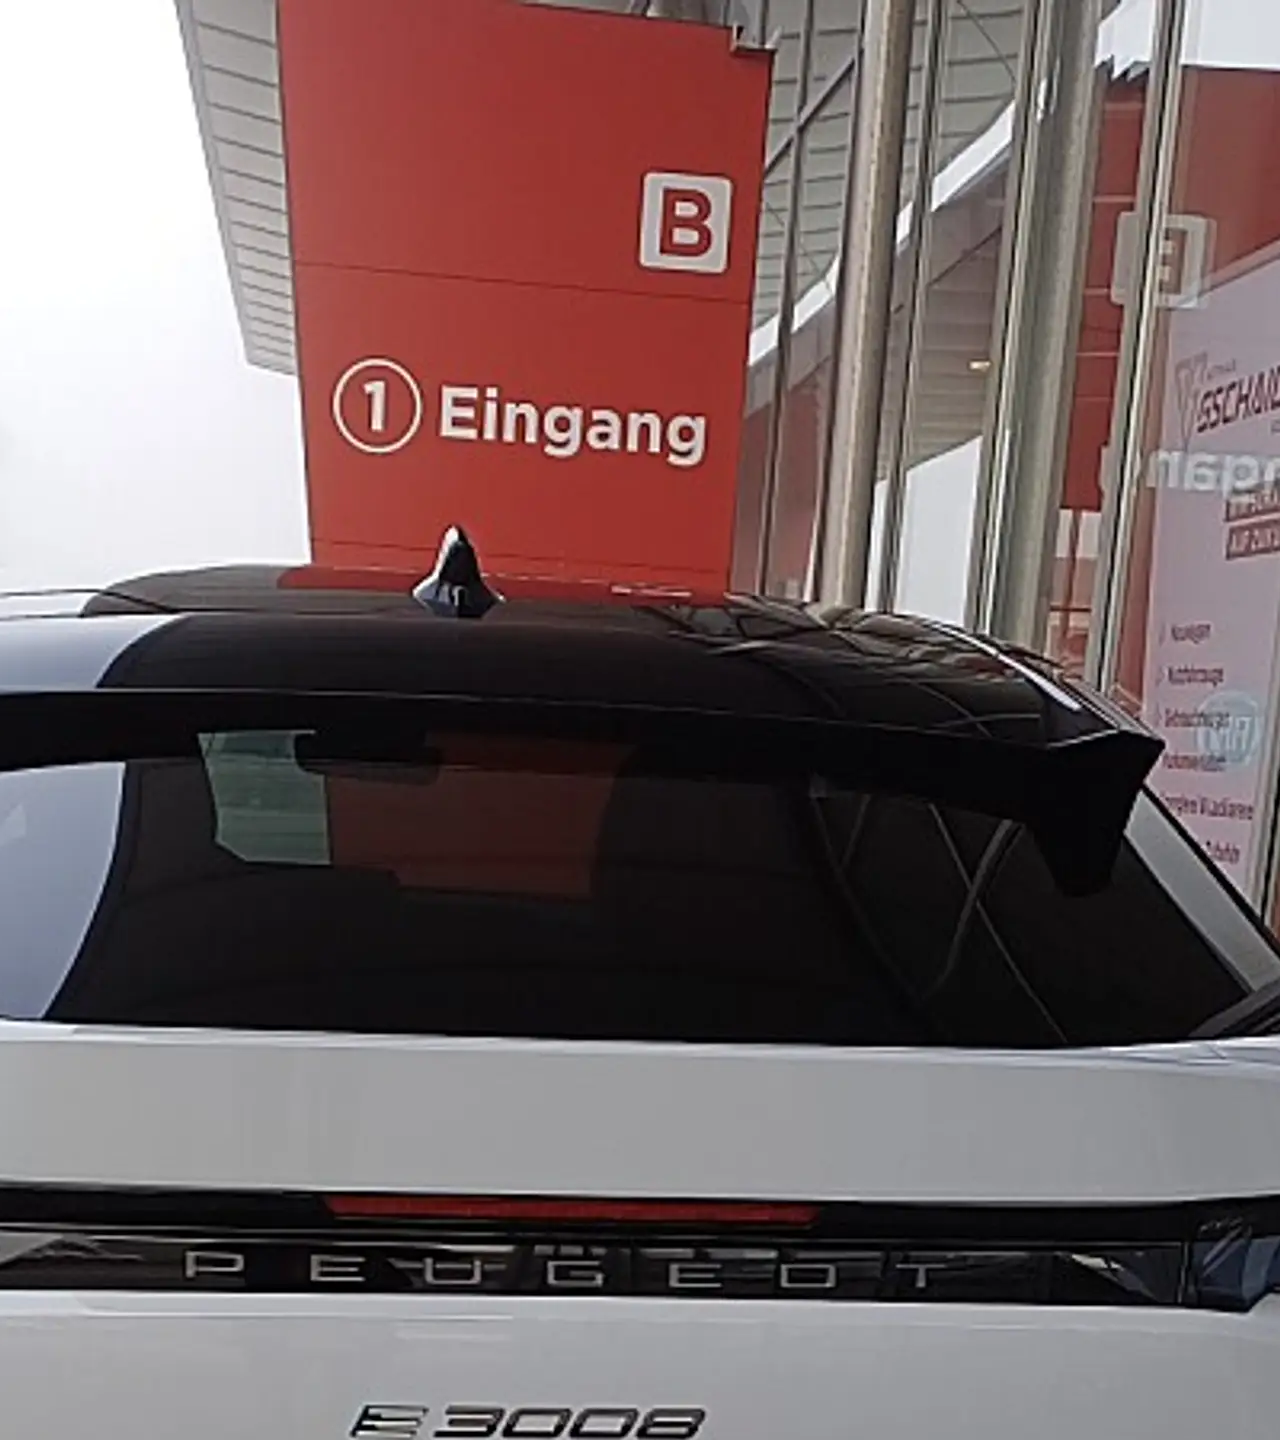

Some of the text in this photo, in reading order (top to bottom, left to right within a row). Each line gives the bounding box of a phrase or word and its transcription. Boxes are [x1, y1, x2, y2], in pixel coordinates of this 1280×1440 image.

[658, 186, 713, 258] B
[362, 380, 707, 467] 1 Eingang
[184, 1250, 946, 1290] PEUGEOT
